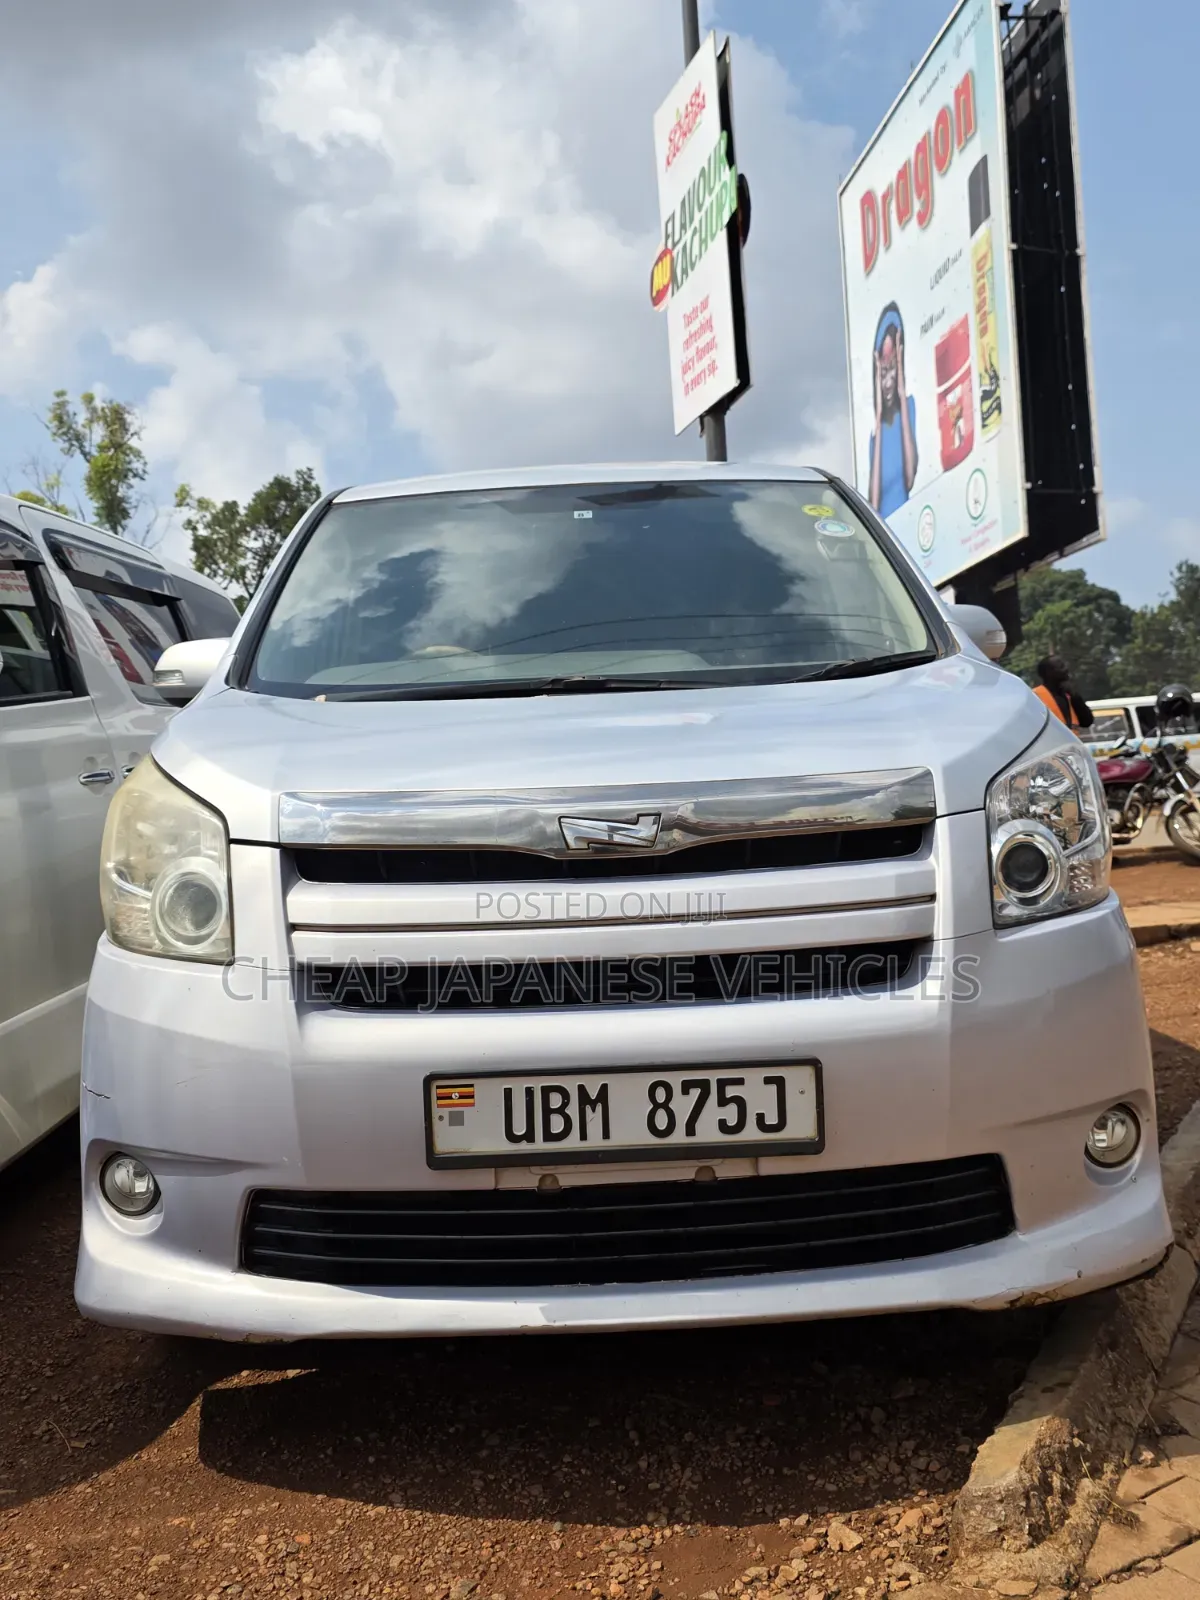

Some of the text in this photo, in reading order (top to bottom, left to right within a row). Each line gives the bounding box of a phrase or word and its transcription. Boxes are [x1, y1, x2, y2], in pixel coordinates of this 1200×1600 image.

[664, 130, 728, 249] FLAVOUR
[860, 70, 976, 276] Dragon
[672, 165, 738, 297] KACHUPA
[683, 295, 709, 328] Taste our
[683, 315, 713, 352] refreshing
[681, 357, 696, 382] juicy
[690, 370, 706, 393] every
[708, 359, 718, 378] sip.
[503, 1074, 787, 1145] UBM 875J
